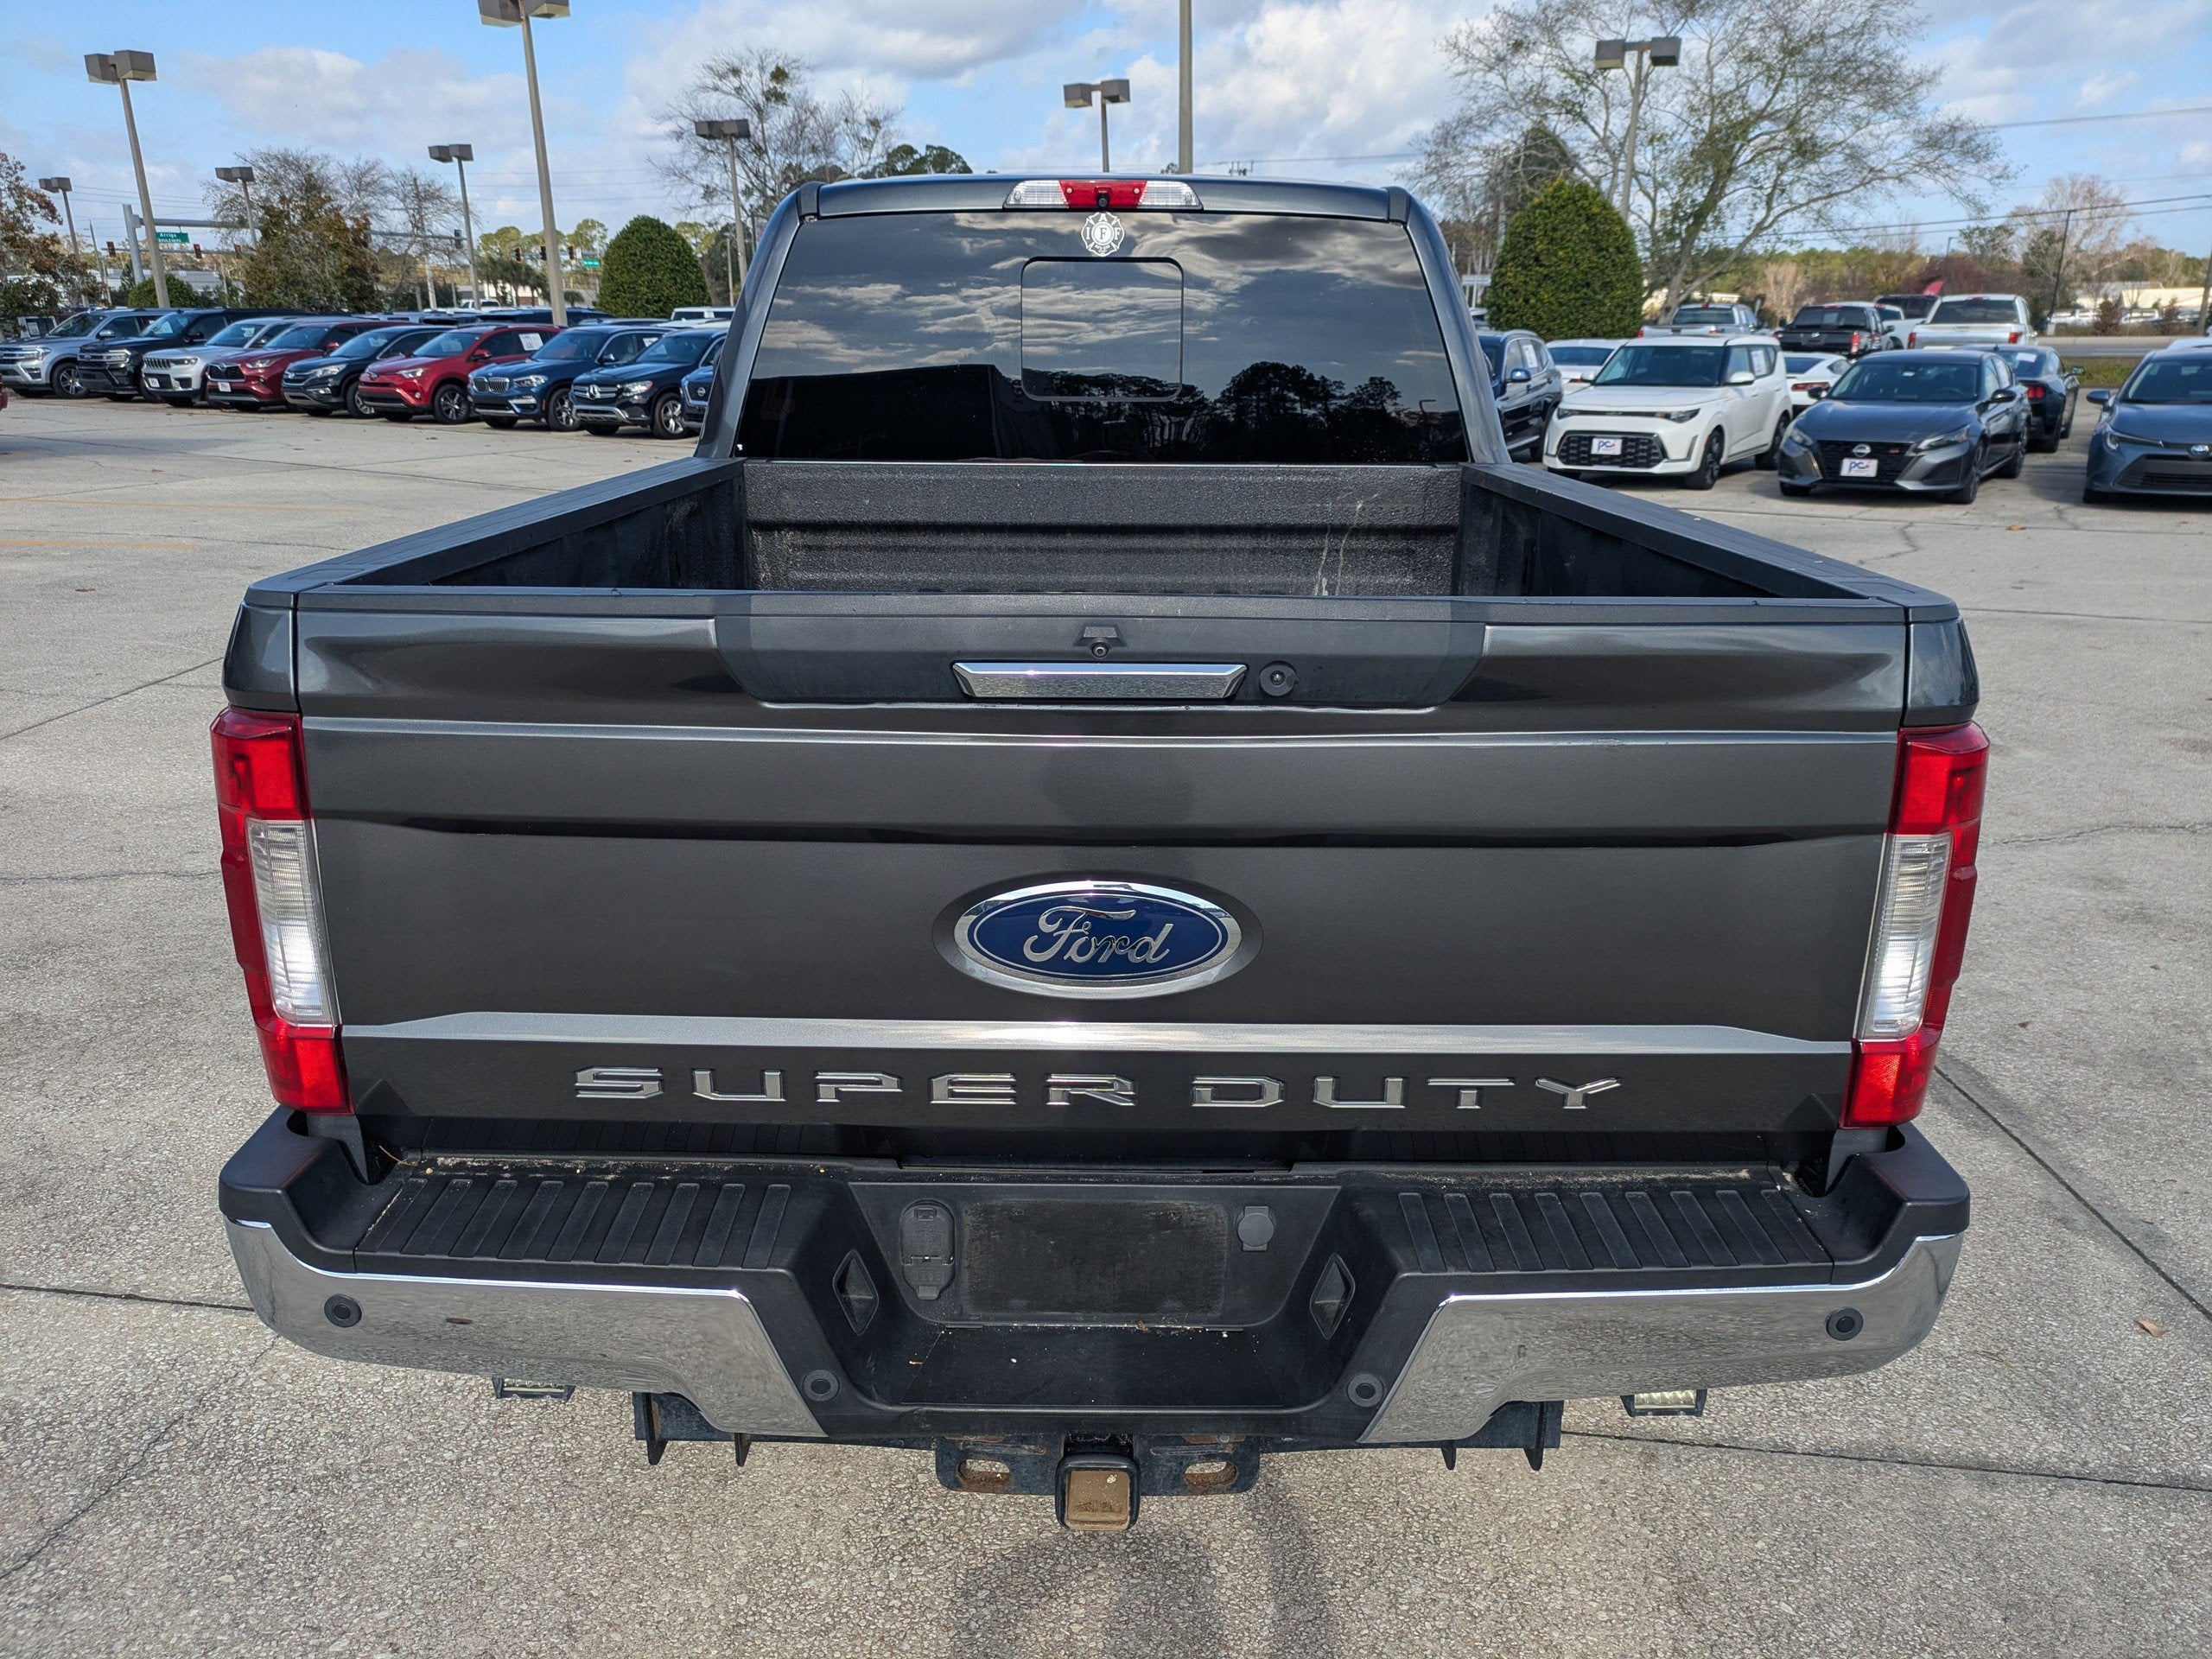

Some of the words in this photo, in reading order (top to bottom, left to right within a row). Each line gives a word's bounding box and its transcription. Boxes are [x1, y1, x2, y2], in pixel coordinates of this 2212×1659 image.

[1098, 213, 1108, 222] A
[1099, 227, 1108, 240] F
[1114, 227, 1122, 240] F
[1023, 906, 1173, 963] Ford
[575, 1066, 1135, 1107] SUPER
[1192, 1076, 1621, 1109] DUTY
